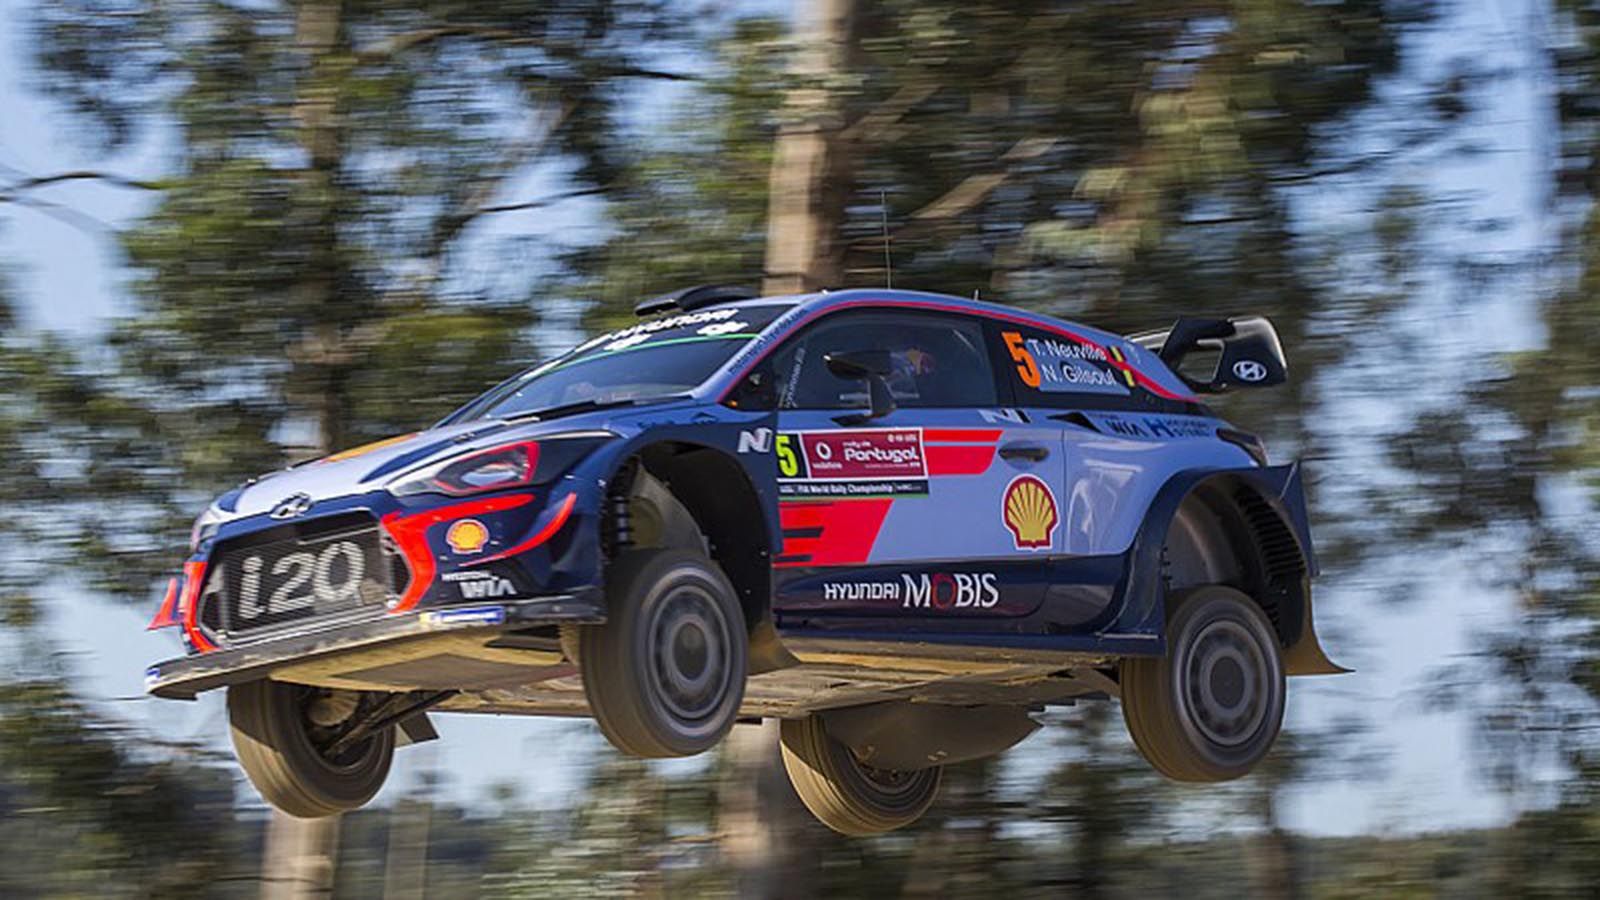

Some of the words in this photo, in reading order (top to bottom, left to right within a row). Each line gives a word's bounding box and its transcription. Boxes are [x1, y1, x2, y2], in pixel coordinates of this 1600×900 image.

[1001, 331, 1041, 388] 5
[1027, 339, 1045, 356] T.
[1045, 339, 1107, 361] Neuville
[1041, 364, 1063, 382] N.
[1063, 364, 1117, 387] Gilsoul
[775, 434, 798, 477] 5
[845, 447, 919, 462] Portugal
[824, 583, 899, 600] HYUNDAI
[901, 573, 999, 610] MOBIS
